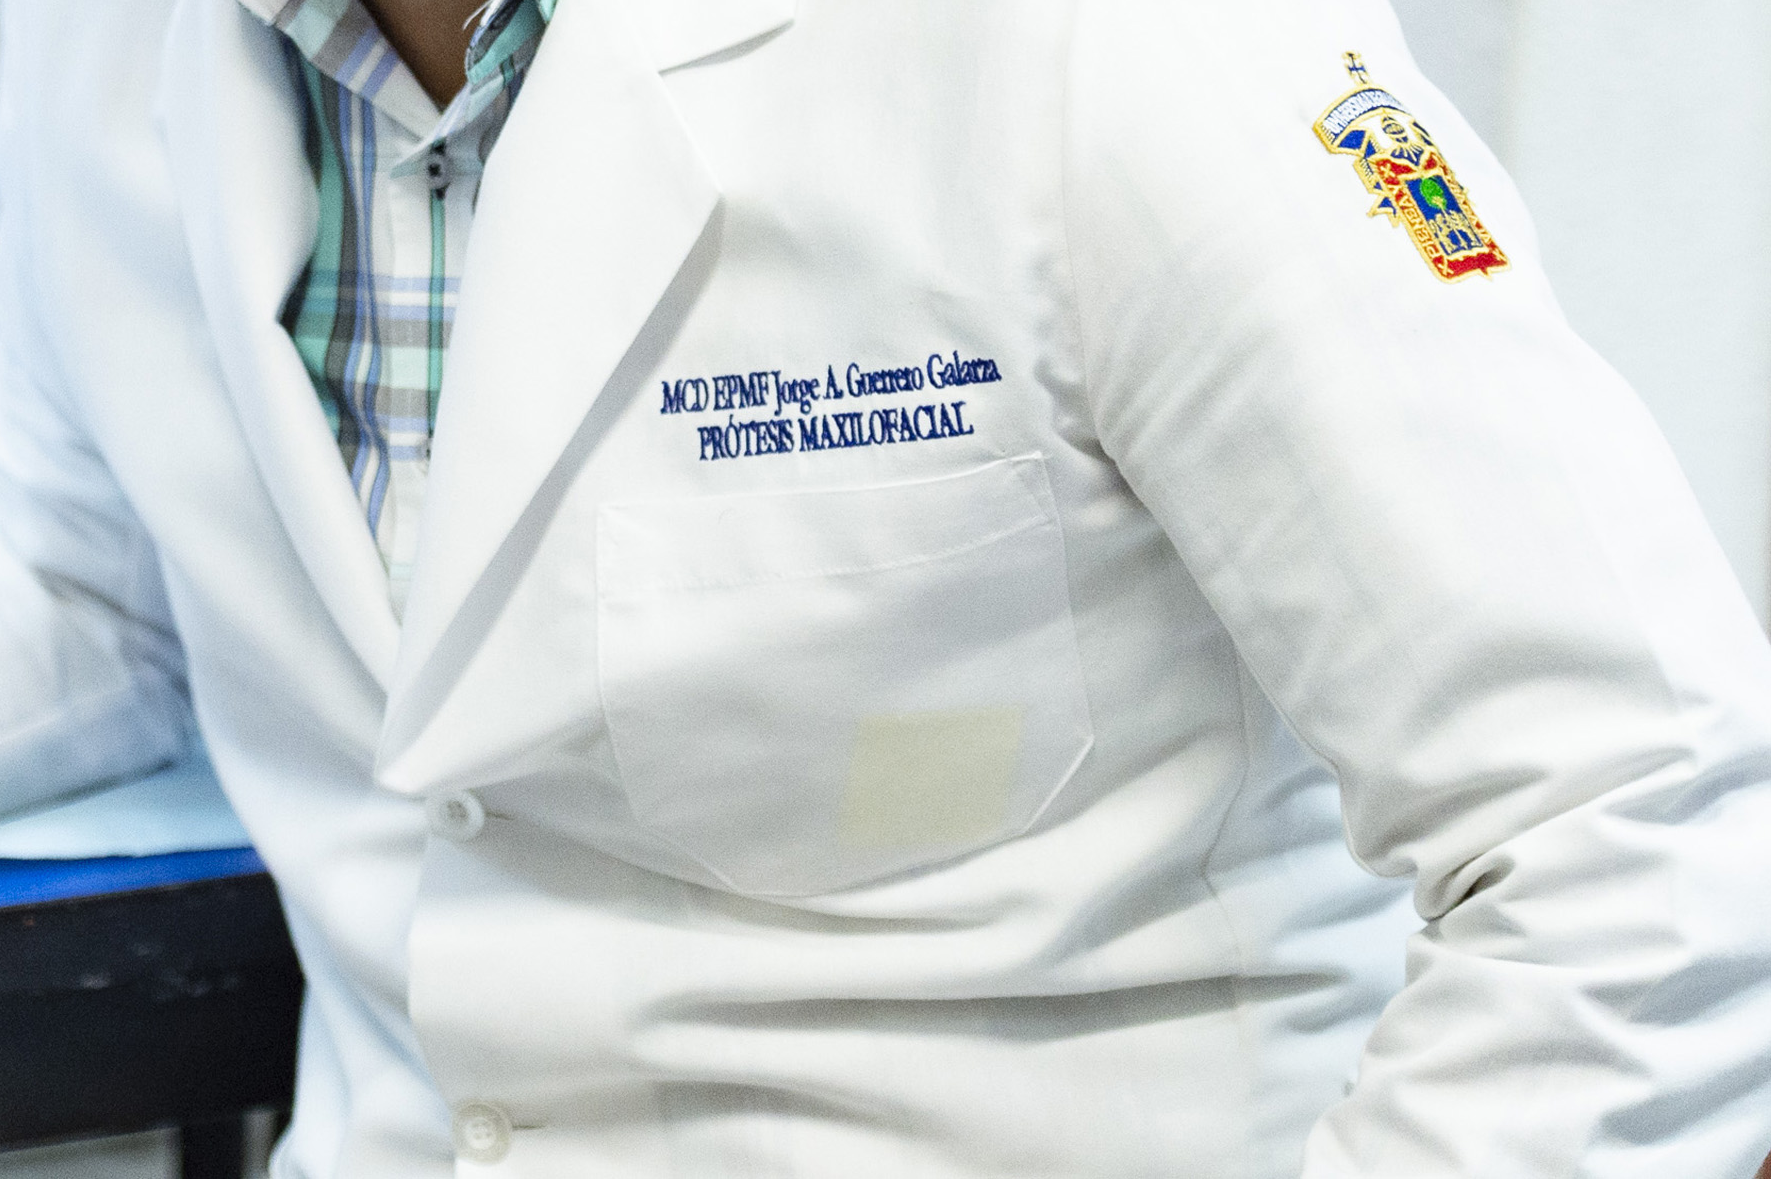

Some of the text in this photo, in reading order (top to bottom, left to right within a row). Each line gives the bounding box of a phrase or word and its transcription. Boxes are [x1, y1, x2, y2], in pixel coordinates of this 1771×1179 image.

[660, 350, 1003, 417] MCD EPMF Jorge A. Guerrero Galarza
[696, 401, 975, 461] PRÓTESIS MAXILOFACIAL
